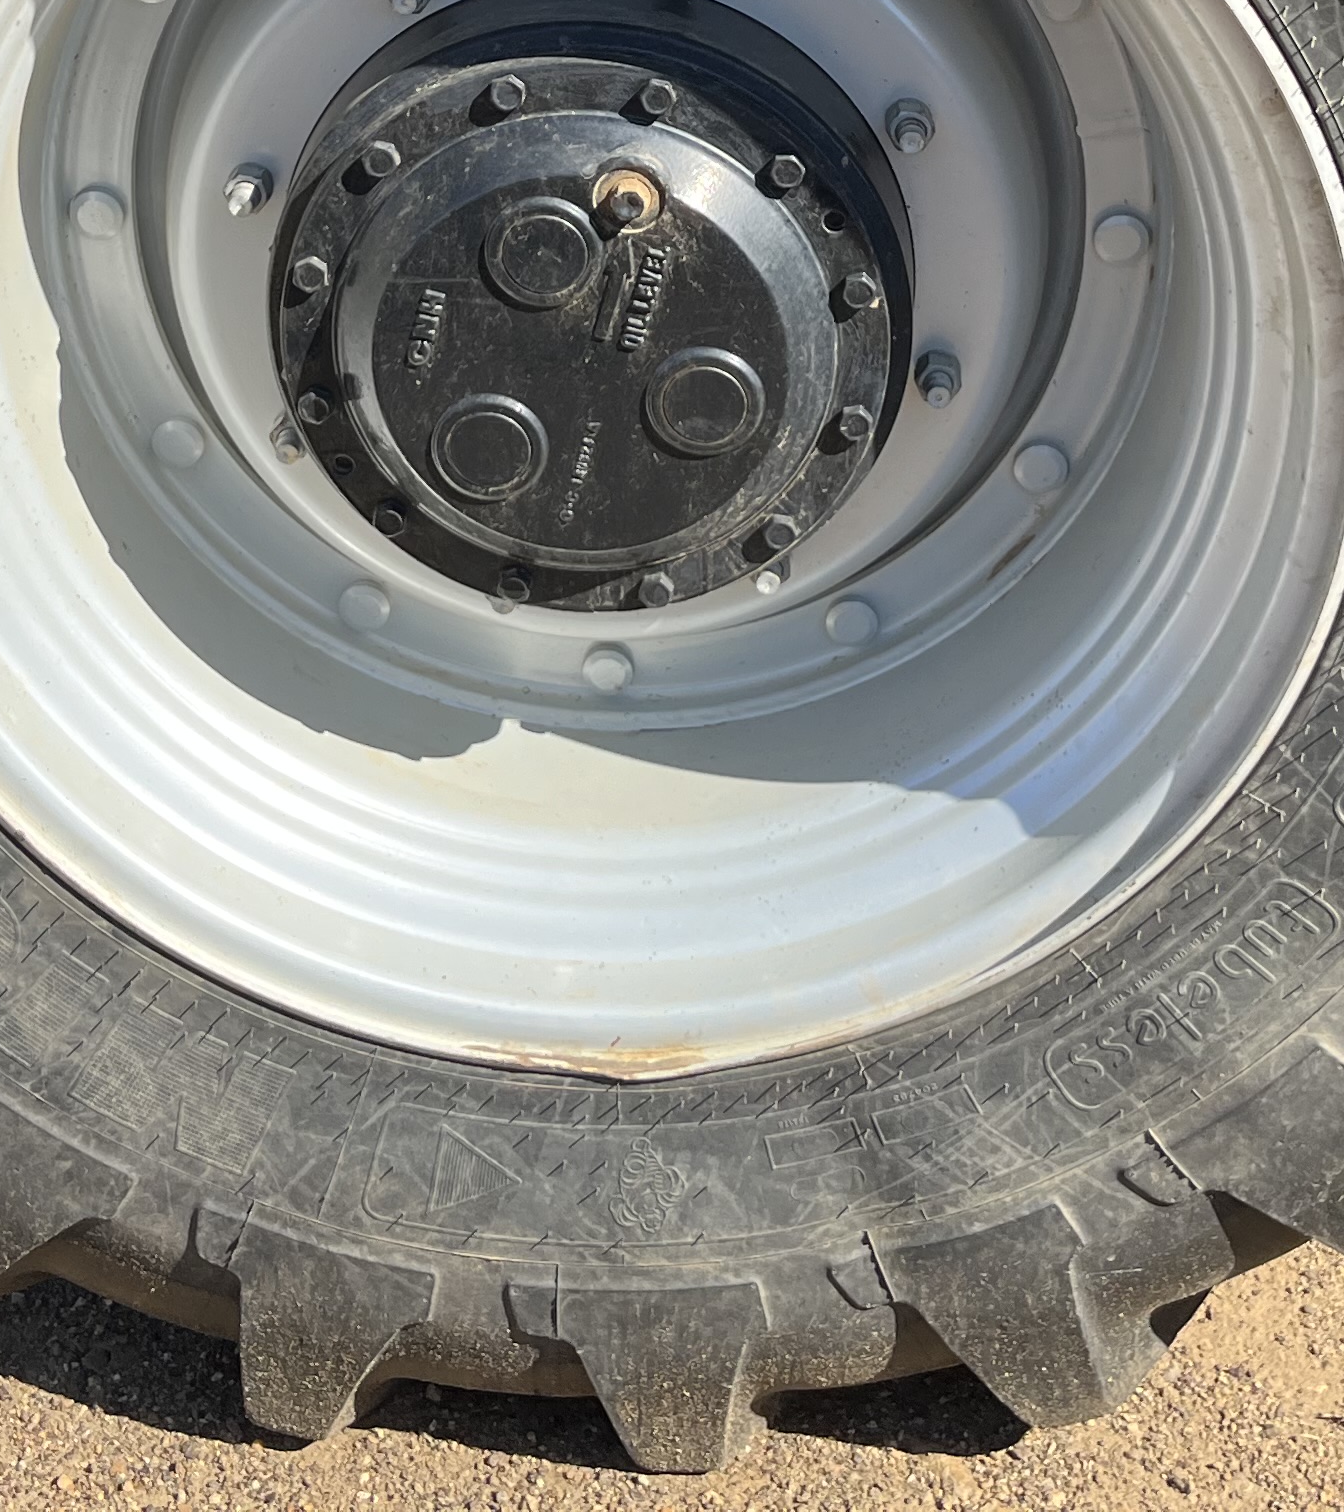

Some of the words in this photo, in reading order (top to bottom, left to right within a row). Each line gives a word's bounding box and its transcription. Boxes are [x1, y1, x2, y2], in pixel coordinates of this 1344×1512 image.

[631, 241, 670, 311] LEVEL
[405, 288, 448, 370] CNH
[619, 311, 650, 351] OIL
[1067, 898, 1324, 1082] tubeless
